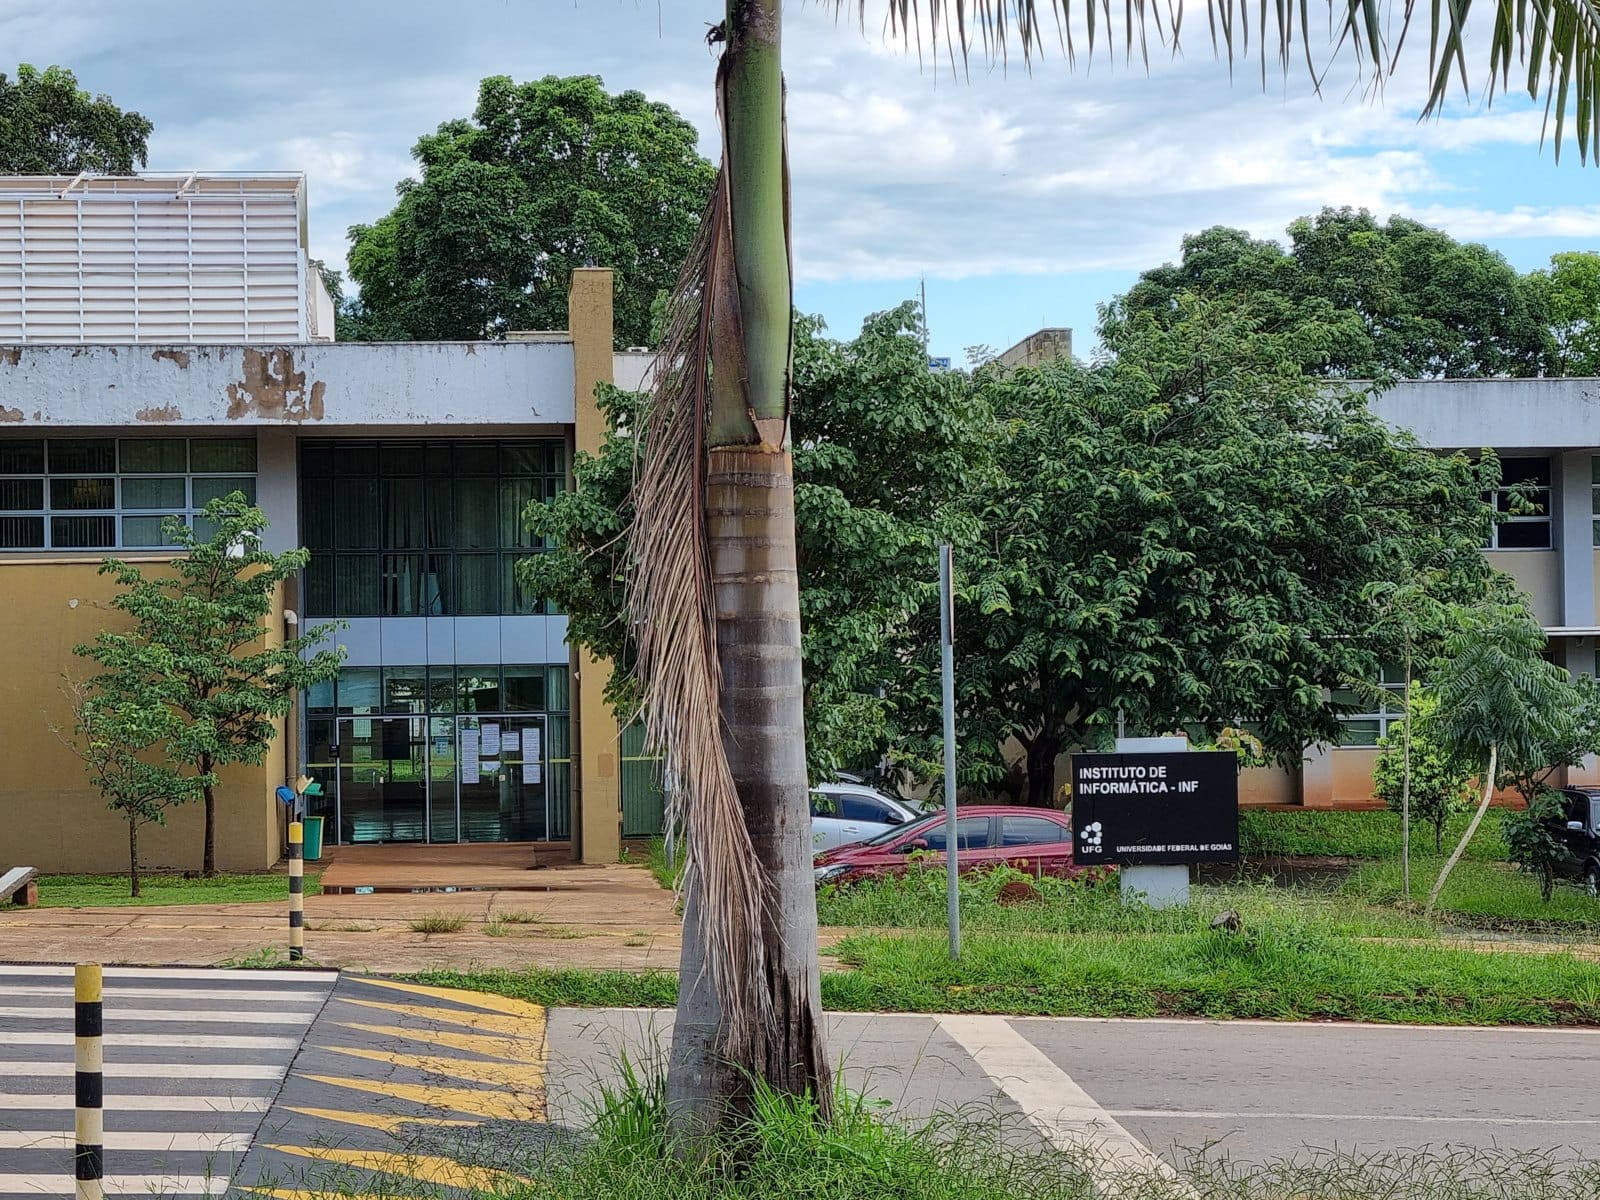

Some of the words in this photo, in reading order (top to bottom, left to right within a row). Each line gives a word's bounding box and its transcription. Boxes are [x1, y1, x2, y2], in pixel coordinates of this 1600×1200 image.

[1079, 767, 1146, 779] INSTITUTO
[1149, 766, 1167, 778] DE
[1079, 780, 1168, 794] INFORMÁTICA
[1178, 780, 1199, 793] INF
[1116, 844, 1166, 853] UNIVERSIDADE
[1167, 844, 1199, 852] FEDERAL
[1200, 843, 1210, 851] DE
[1210, 842, 1232, 851] GOIÁS
